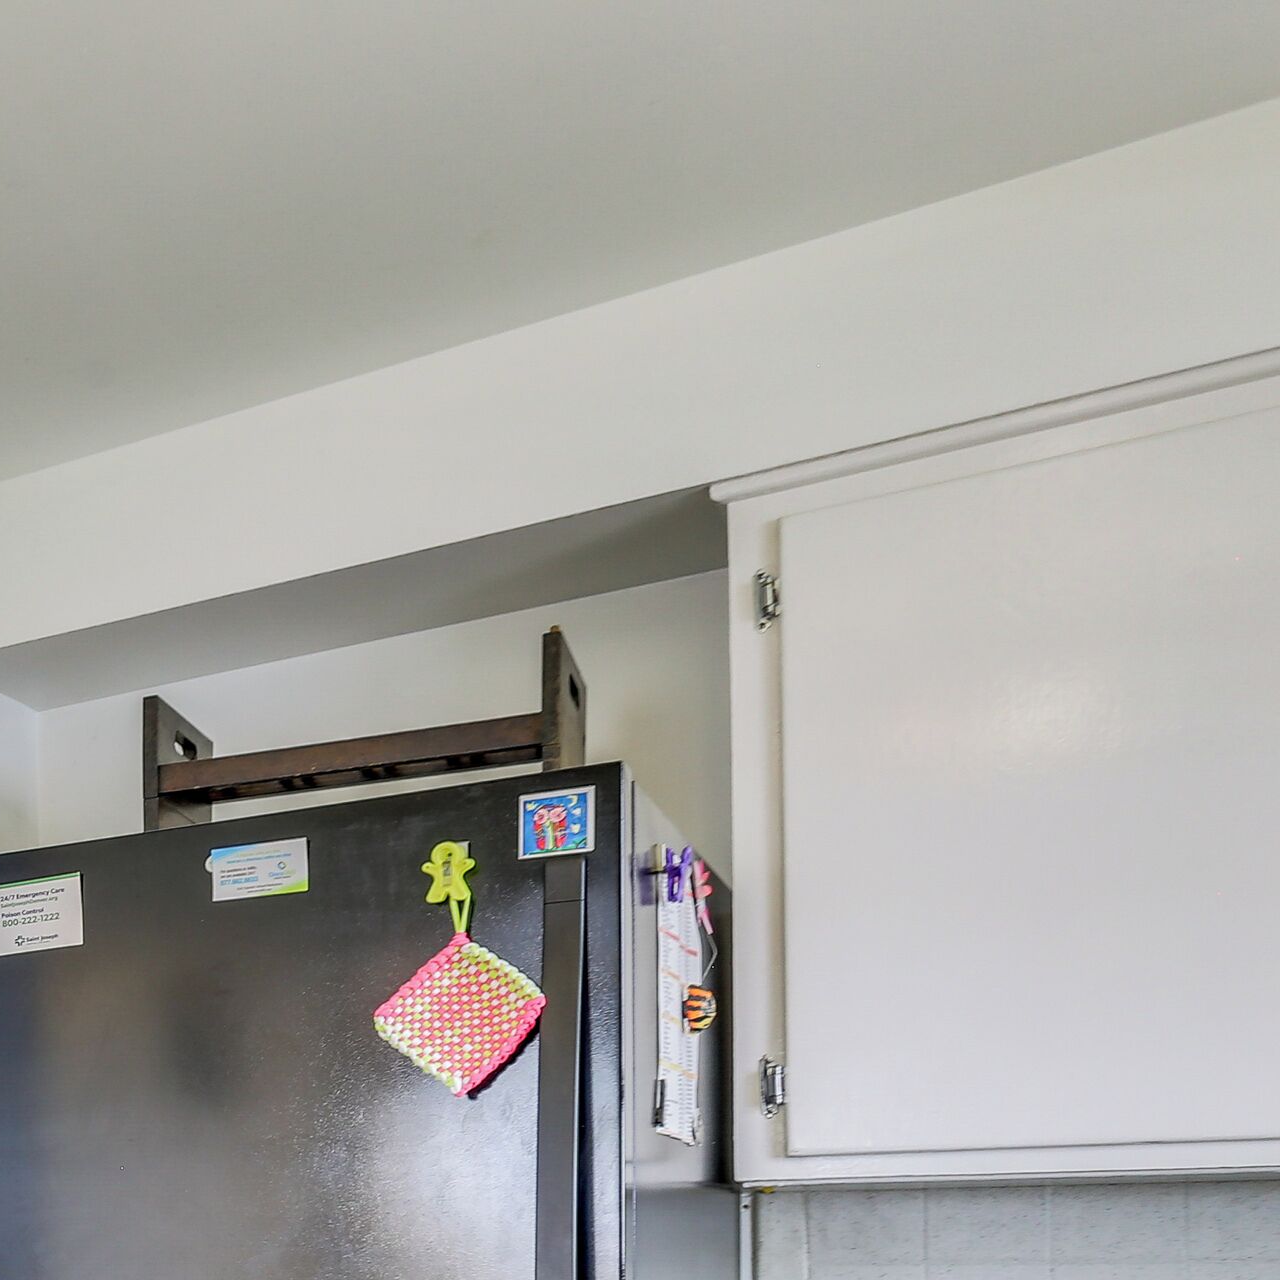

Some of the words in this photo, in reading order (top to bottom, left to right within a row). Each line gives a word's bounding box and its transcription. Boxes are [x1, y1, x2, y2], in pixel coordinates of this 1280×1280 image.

[16, 890, 49, 899] Emergency
[1, 911, 20, 919] Poison
[21, 907, 44, 916] Control
[2, 912, 60, 927] 800-222-1222
